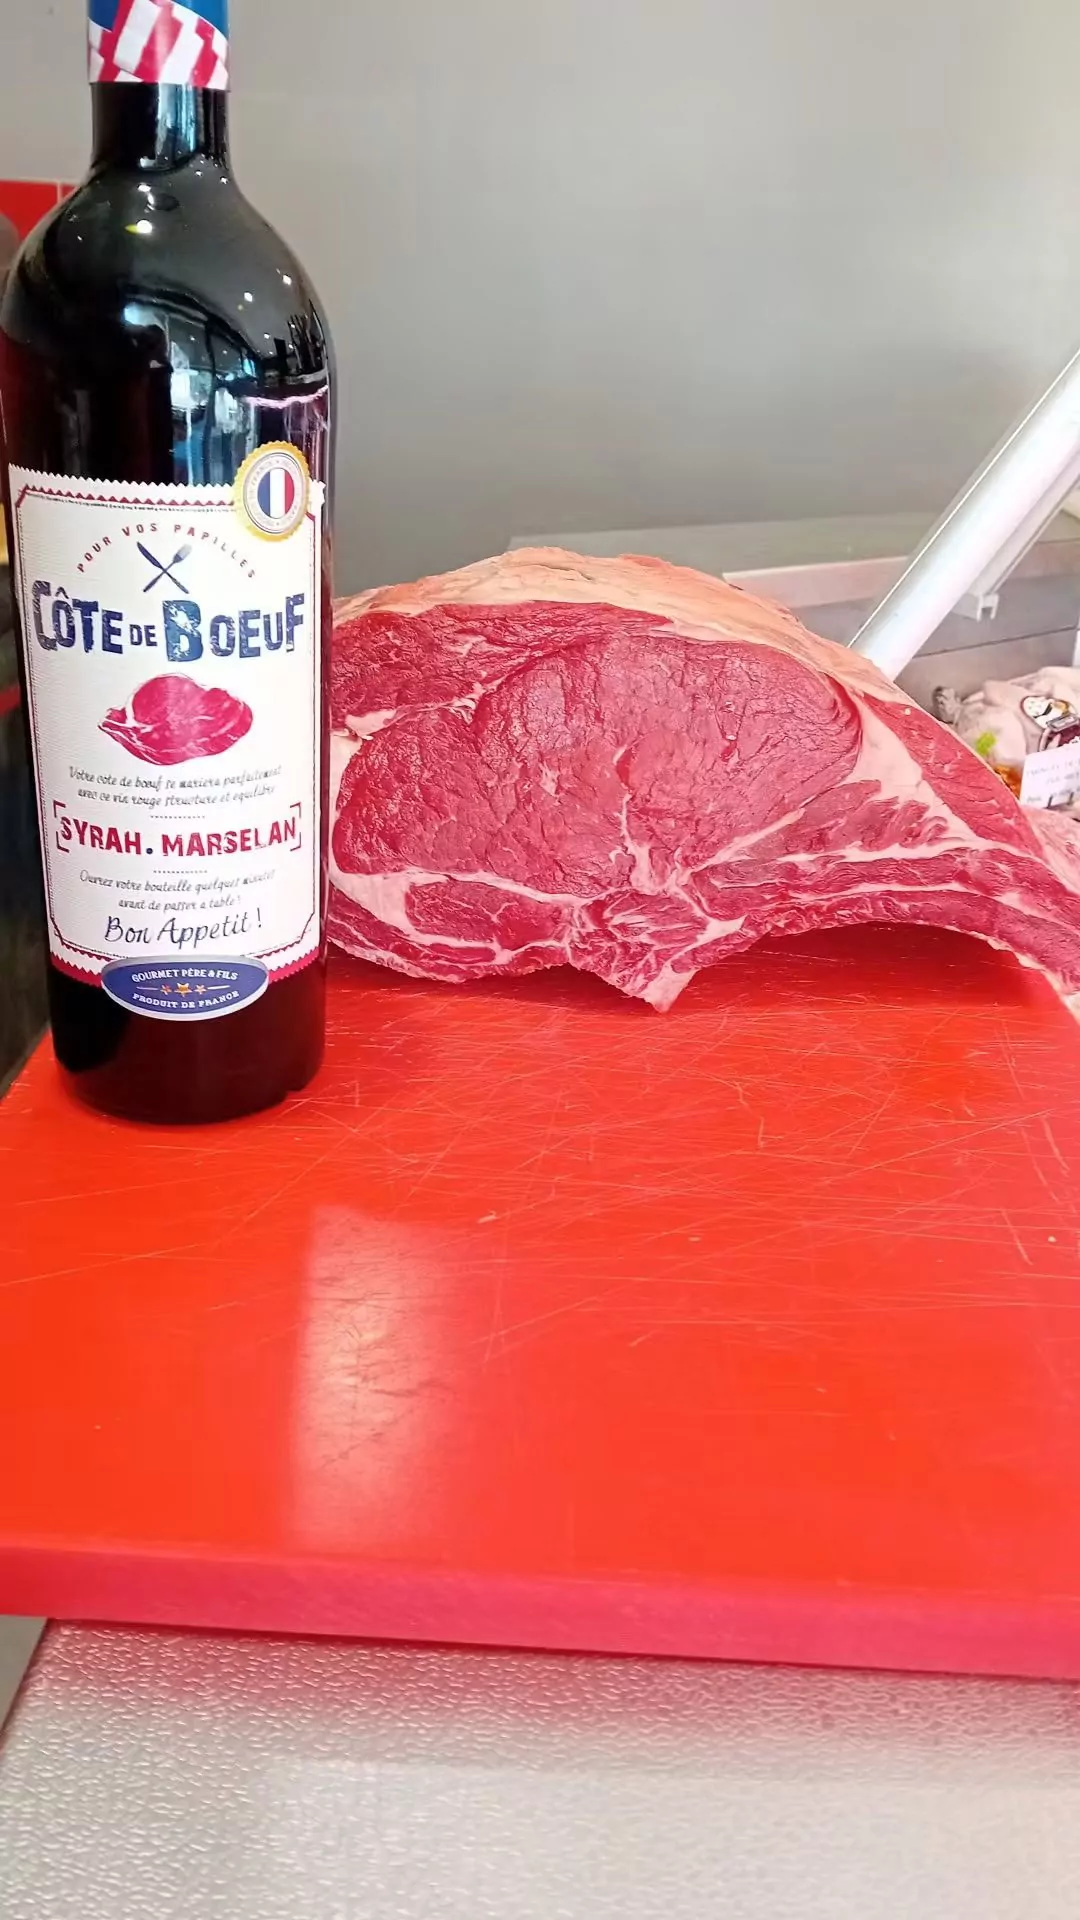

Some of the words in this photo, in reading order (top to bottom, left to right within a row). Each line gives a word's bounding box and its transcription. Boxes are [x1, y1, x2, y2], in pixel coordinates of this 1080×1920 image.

[77, 536, 112, 573] POUR
[122, 523, 158, 537] VOS
[174, 524, 256, 578] PAPILLES
[32, 580, 123, 654] CÔTE
[129, 624, 158, 647] DE
[162, 593, 305, 662] BOEUF
[69, 766, 95, 782] Votre
[120, 776, 132, 787] de
[132, 795, 162, 809] rouge
[161, 816, 296, 857] MARSELAN
[80, 869, 113, 887] Ouvrez
[115, 879, 141, 891] votre
[145, 879, 192, 892] bouteille
[119, 899, 146, 910] avant
[148, 900, 161, 910] de
[163, 901, 197, 914] passer
[104, 915, 150, 943] Bon
[131, 969, 179, 982] GOURMET
[208, 969, 215, 978] &
[215, 970, 239, 981] FILS
[132, 993, 178, 1009] PRODUIT
[181, 1000, 196, 1009] DE
[198, 990, 240, 1006] FRANCE
